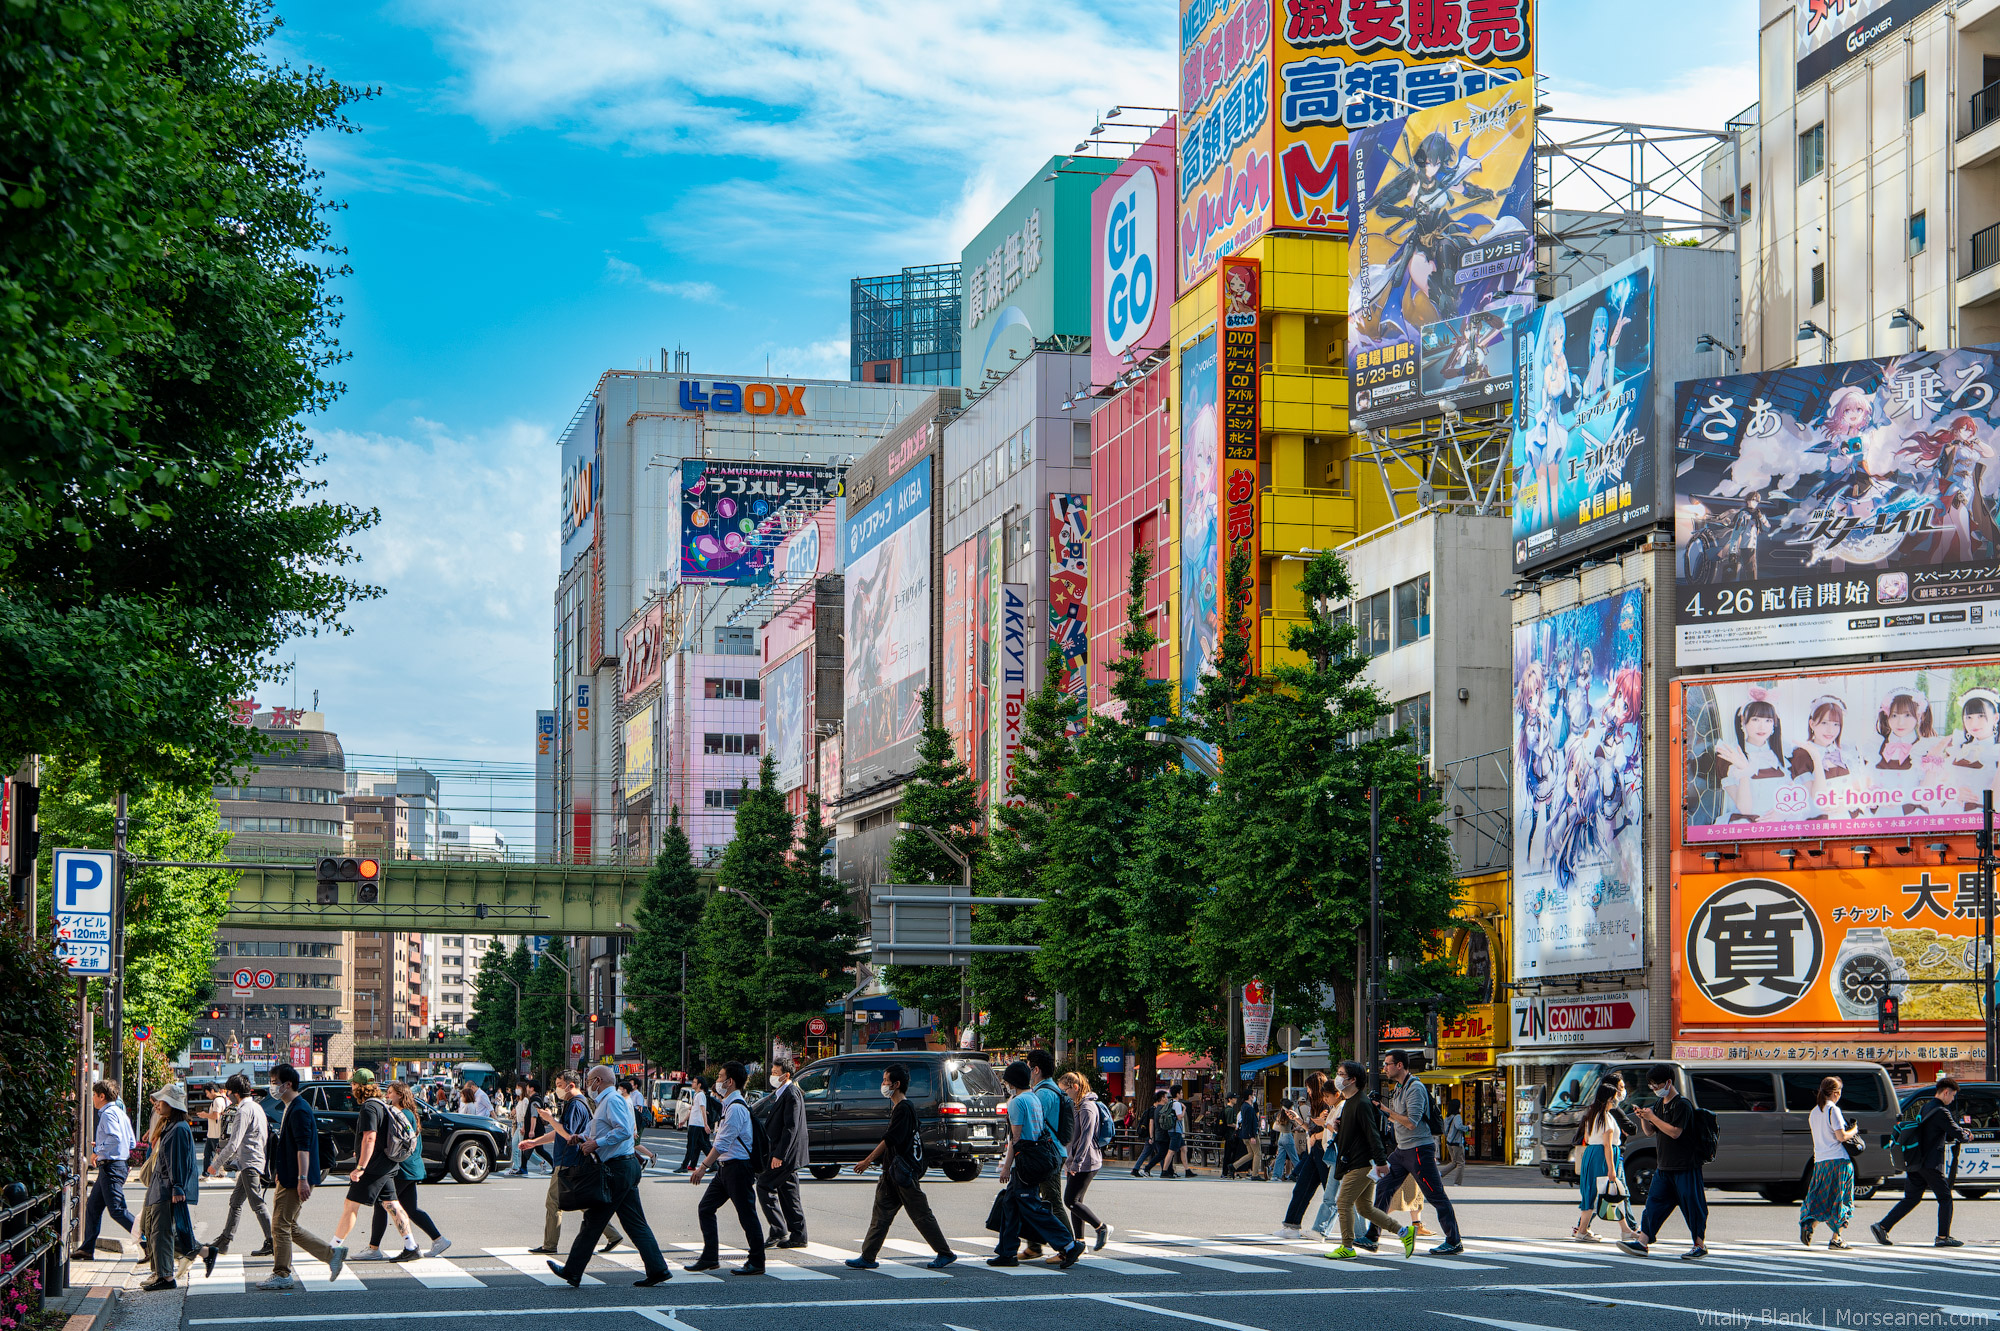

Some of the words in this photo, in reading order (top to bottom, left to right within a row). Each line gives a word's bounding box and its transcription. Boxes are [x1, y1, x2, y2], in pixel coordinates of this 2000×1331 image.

[1286, 0, 1521, 56] 激安販売
[1183, 0, 1267, 118] 激安販売
[1182, 58, 1267, 197] 高額買取
[1181, 149, 1271, 283] Mulan
[1308, 207, 1348, 226] ムー
[1485, 241, 1521, 259] ツクヨミ
[1190, 253, 1215, 284] ムーラン
[1215, 237, 1234, 263] AKIBA
[1459, 272, 1471, 280] CV
[1472, 263, 1505, 278] 石川由依
[1226, 312, 1256, 328] あなたの
[1228, 332, 1253, 345] DVD
[1226, 347, 1254, 359] ブルーレイ
[1227, 361, 1254, 373] ゲーム
[1232, 375, 1249, 387] CD
[1494, 381, 1512, 391] YOST
[1227, 389, 1253, 401] アイドル
[1226, 403, 1254, 415] アニメ
[1228, 418, 1252, 430] コミック
[1229, 432, 1252, 443] ホビー
[889, 424, 926, 476] ビックカメラ
[1228, 446, 1253, 458] フィギュア
[720, 468, 783, 477] AMUSEMENT
[786, 470, 813, 478] PARK
[851, 476, 875, 506] Sofmap
[860, 498, 893, 543] ソフマップ
[898, 477, 922, 515] AKIBA
[1579, 481, 1632, 525] 配信開始
[1628, 504, 1650, 520] YOSTAR
[788, 529, 816, 584] GiGO
[945, 563, 957, 597] 4F
[1685, 588, 1754, 617] 4.26
[1761, 581, 1870, 612] 配信開始
[1005, 588, 1025, 660] AKKY
[945, 672, 956, 704] 3F
[1911, 784, 1957, 803] cafe
[66, 859, 103, 906] P
[61, 915, 106, 928] ダイビル
[1832, 905, 1893, 923] チケット
[72, 928, 108, 940] 120m先
[1702, 898, 1811, 1000] 質
[79, 957, 100, 968] 左折
[259, 974, 271, 985] 50
[1515, 1000, 1528, 1008] COMIC
[1515, 998, 1545, 1041] ZIN
[1549, 1006, 1592, 1030] COMIC
[1594, 1006, 1613, 1028] ZIN
[1549, 1032, 1585, 1042] Akihabara
[1675, 1045, 1724, 1060] 高価買取
